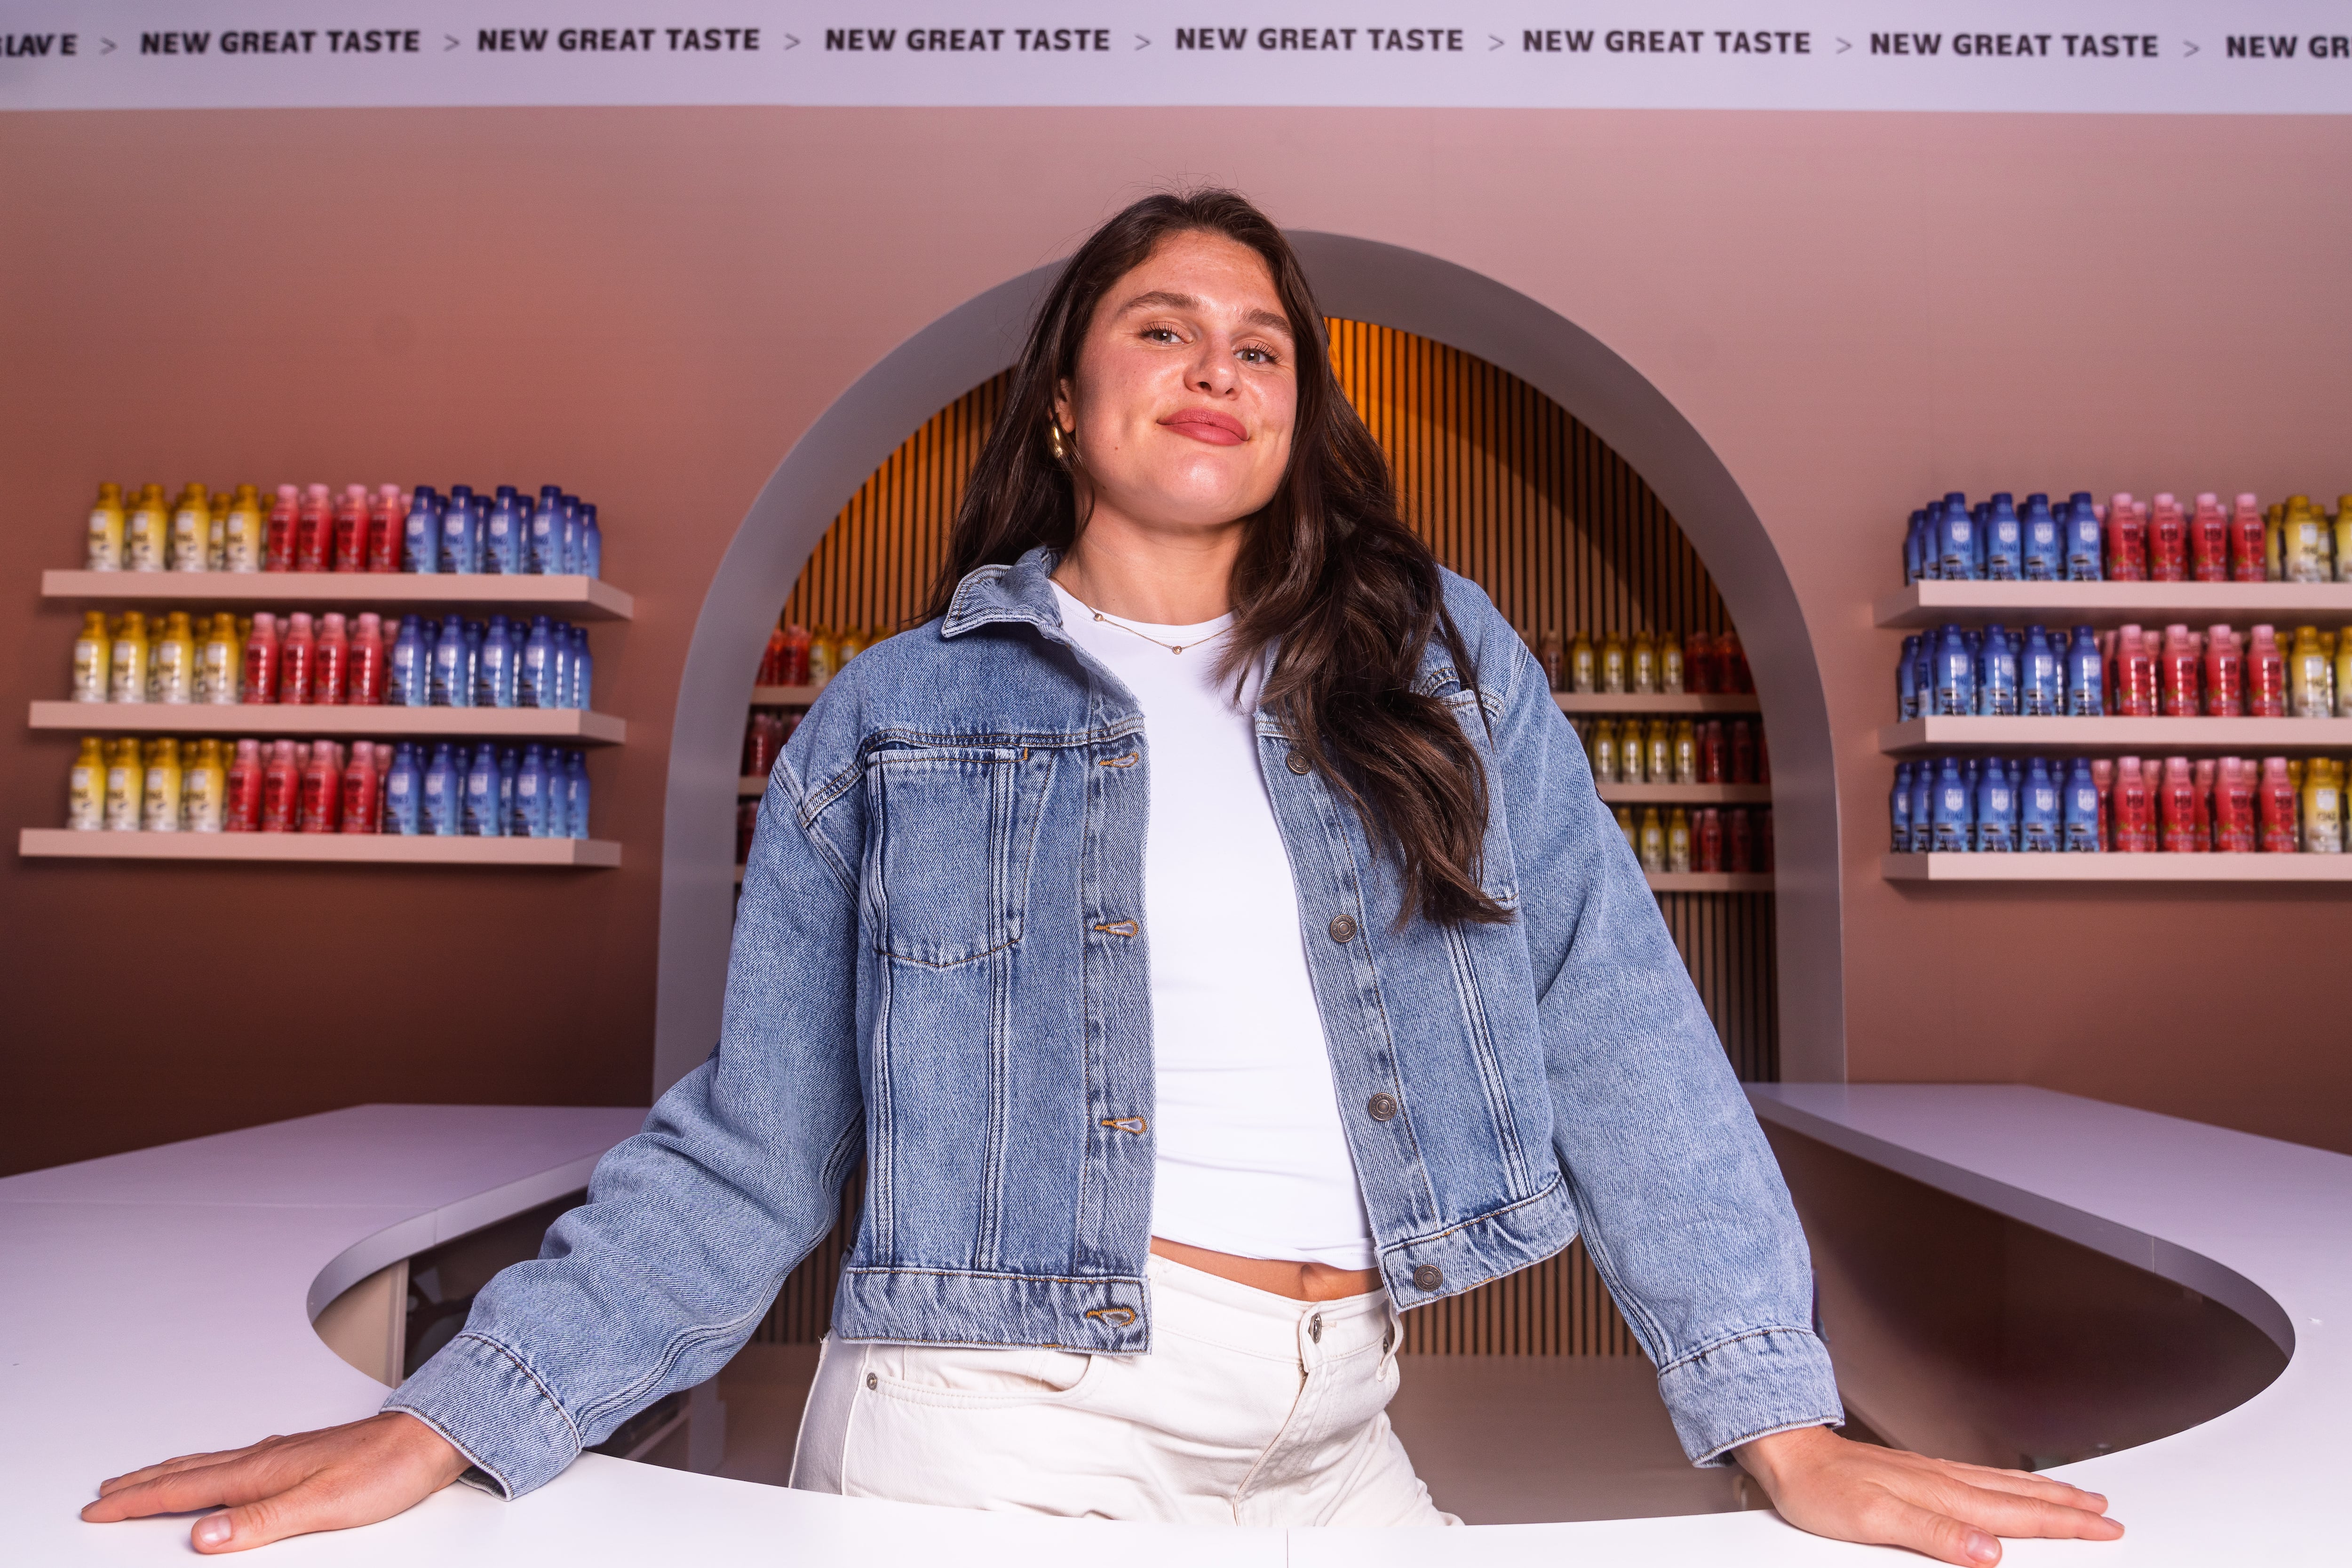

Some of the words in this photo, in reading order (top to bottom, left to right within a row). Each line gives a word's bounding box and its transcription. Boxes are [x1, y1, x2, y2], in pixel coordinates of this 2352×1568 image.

[0, 34, 77, 57] LAVE
[140, 32, 211, 54] NEW
[219, 31, 317, 54] GREAT
[326, 30, 420, 52] TASTE
[477, 29, 548, 51] NEW
[557, 28, 656, 51] GREAT
[665, 28, 760, 50] TASTE
[825, 29, 897, 50] NEW
[906, 29, 1005, 51] GREAT
[1014, 29, 1110, 51] TASTE
[1176, 28, 1247, 49] NEW
[1257, 28, 1357, 50] GREAT
[1367, 29, 1462, 50] TASTE
[1523, 30, 1594, 52] NEW
[1605, 30, 1704, 52] GREAT
[1714, 31, 1810, 53] TASTE
[1870, 33, 1941, 55] NEW
[1952, 33, 2051, 56] GREAT
[2061, 34, 2158, 57] TASTE
[2226, 36, 2297, 57] NEW
[2308, 35, 2352, 58] GR
